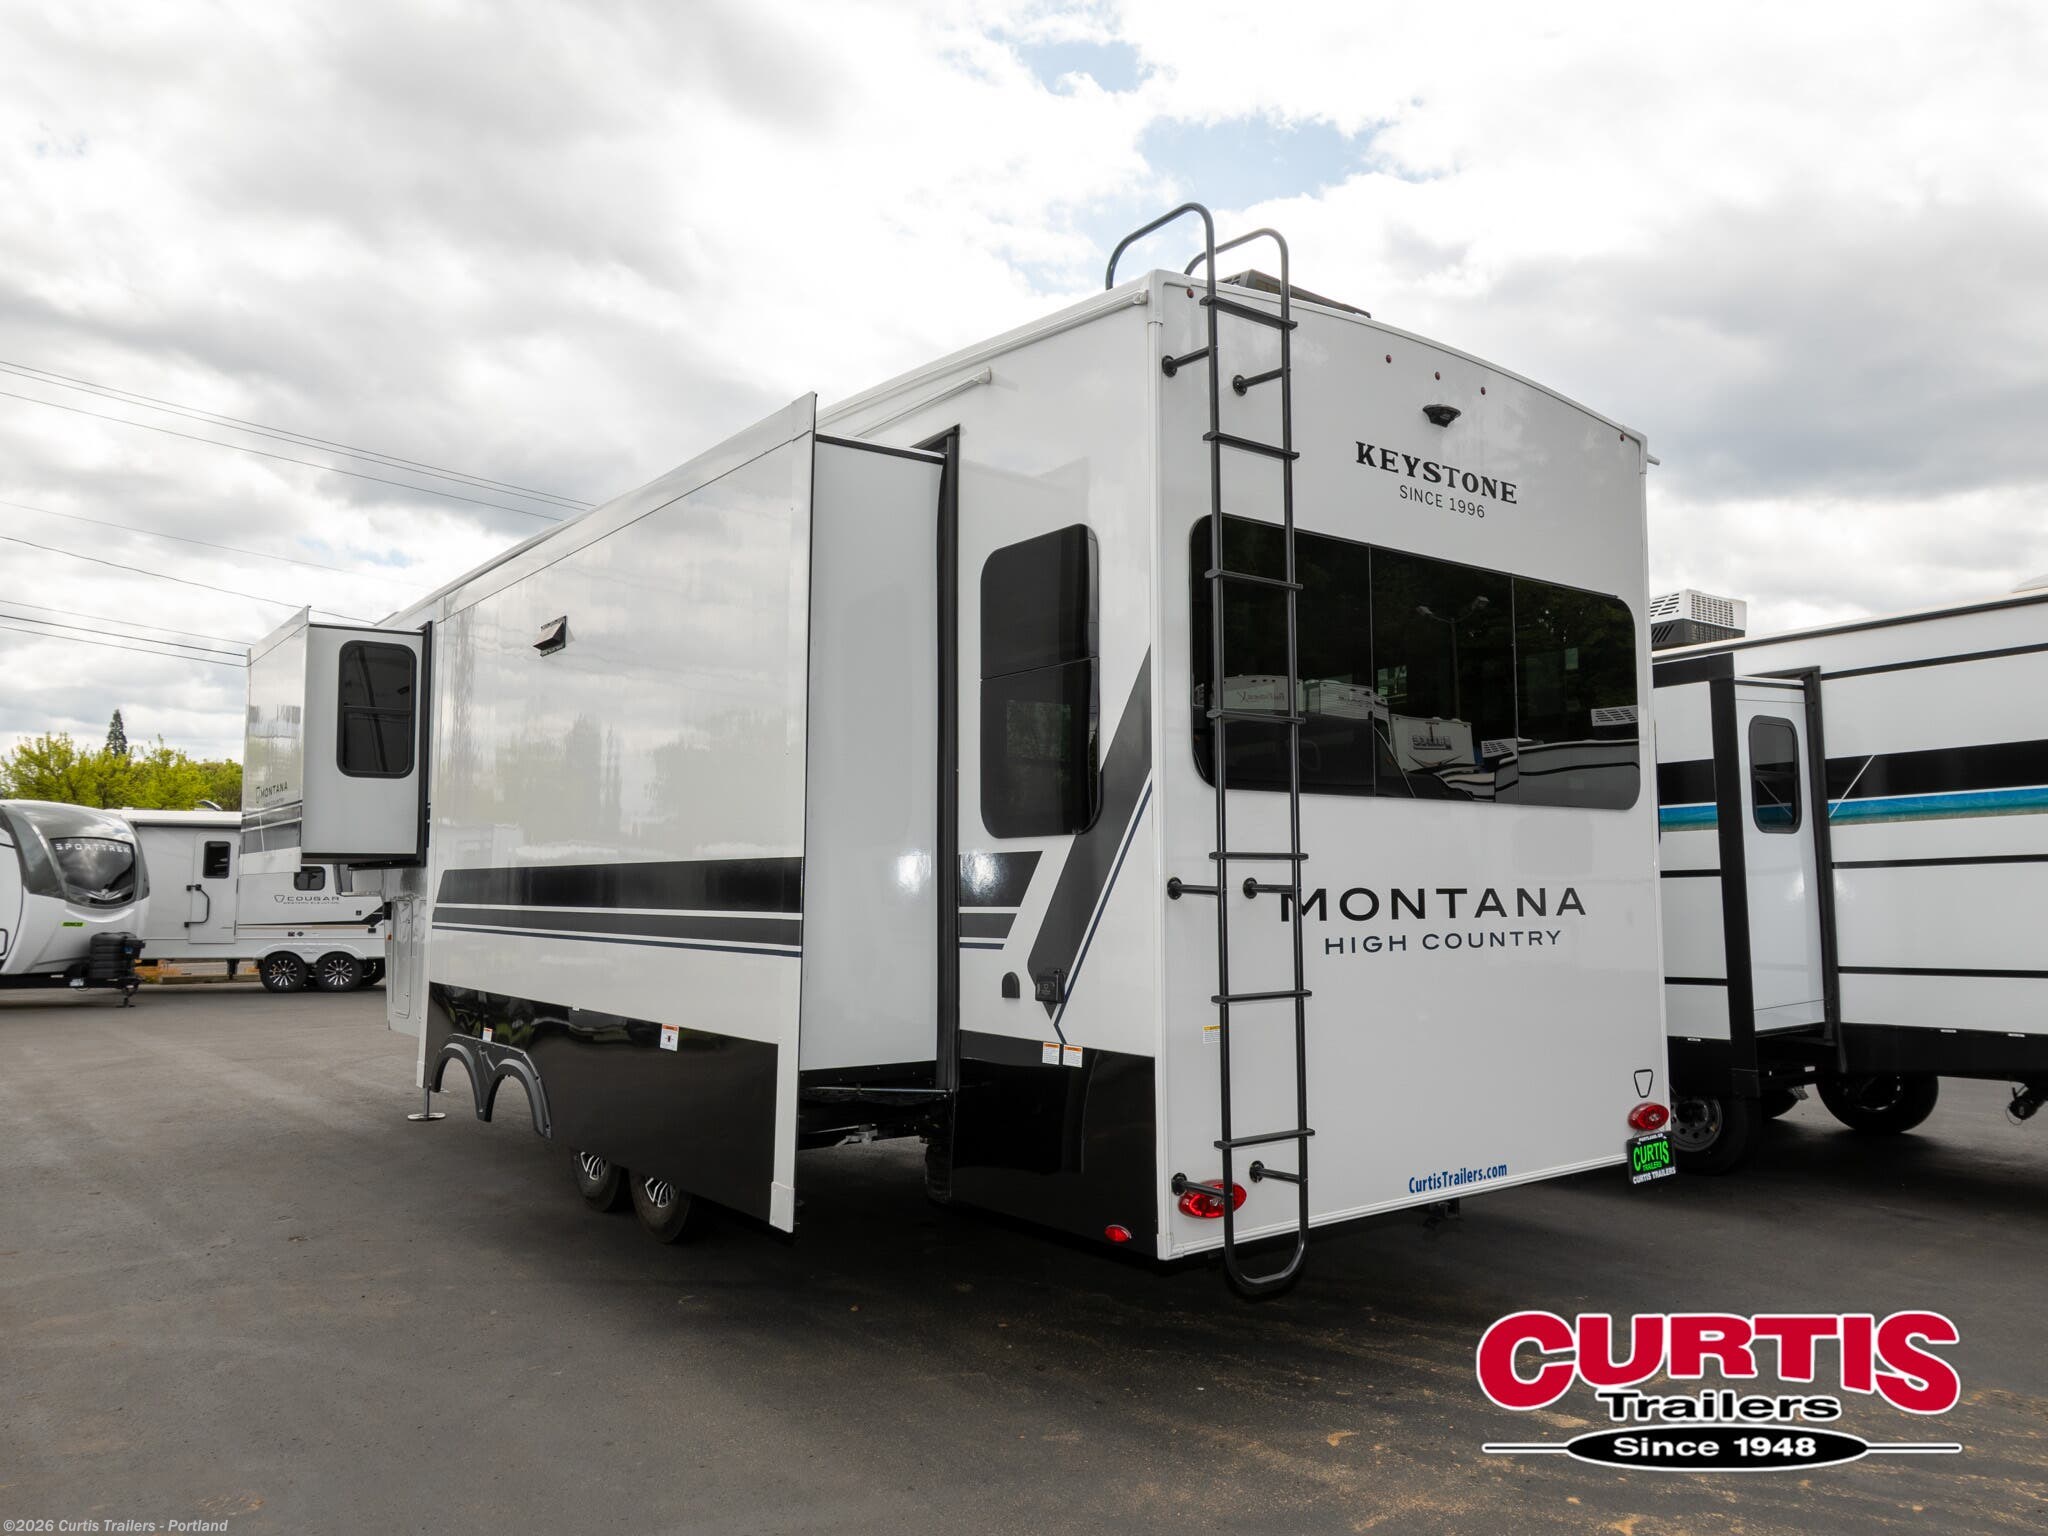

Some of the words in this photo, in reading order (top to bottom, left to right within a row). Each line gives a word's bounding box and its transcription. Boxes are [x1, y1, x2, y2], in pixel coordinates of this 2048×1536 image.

[1355, 441, 1517, 504] KEYSTONE
[1399, 485, 1444, 508] SINCE
[1449, 498, 1485, 518] 1996
[260, 781, 288, 798] MONTANA
[55, 842, 130, 854] SPORTTREK
[1280, 887, 1587, 922] MONTANA
[1325, 935, 1407, 955] HIGH
[1422, 930, 1561, 951] COUNTRY
[1633, 1140, 1669, 1171] CURTIS
[1409, 1164, 1507, 1193] CurtisTrailers.com
[1633, 1172, 1652, 1184] CURTIS
[1651, 1166, 1676, 1179] TRAILERS
